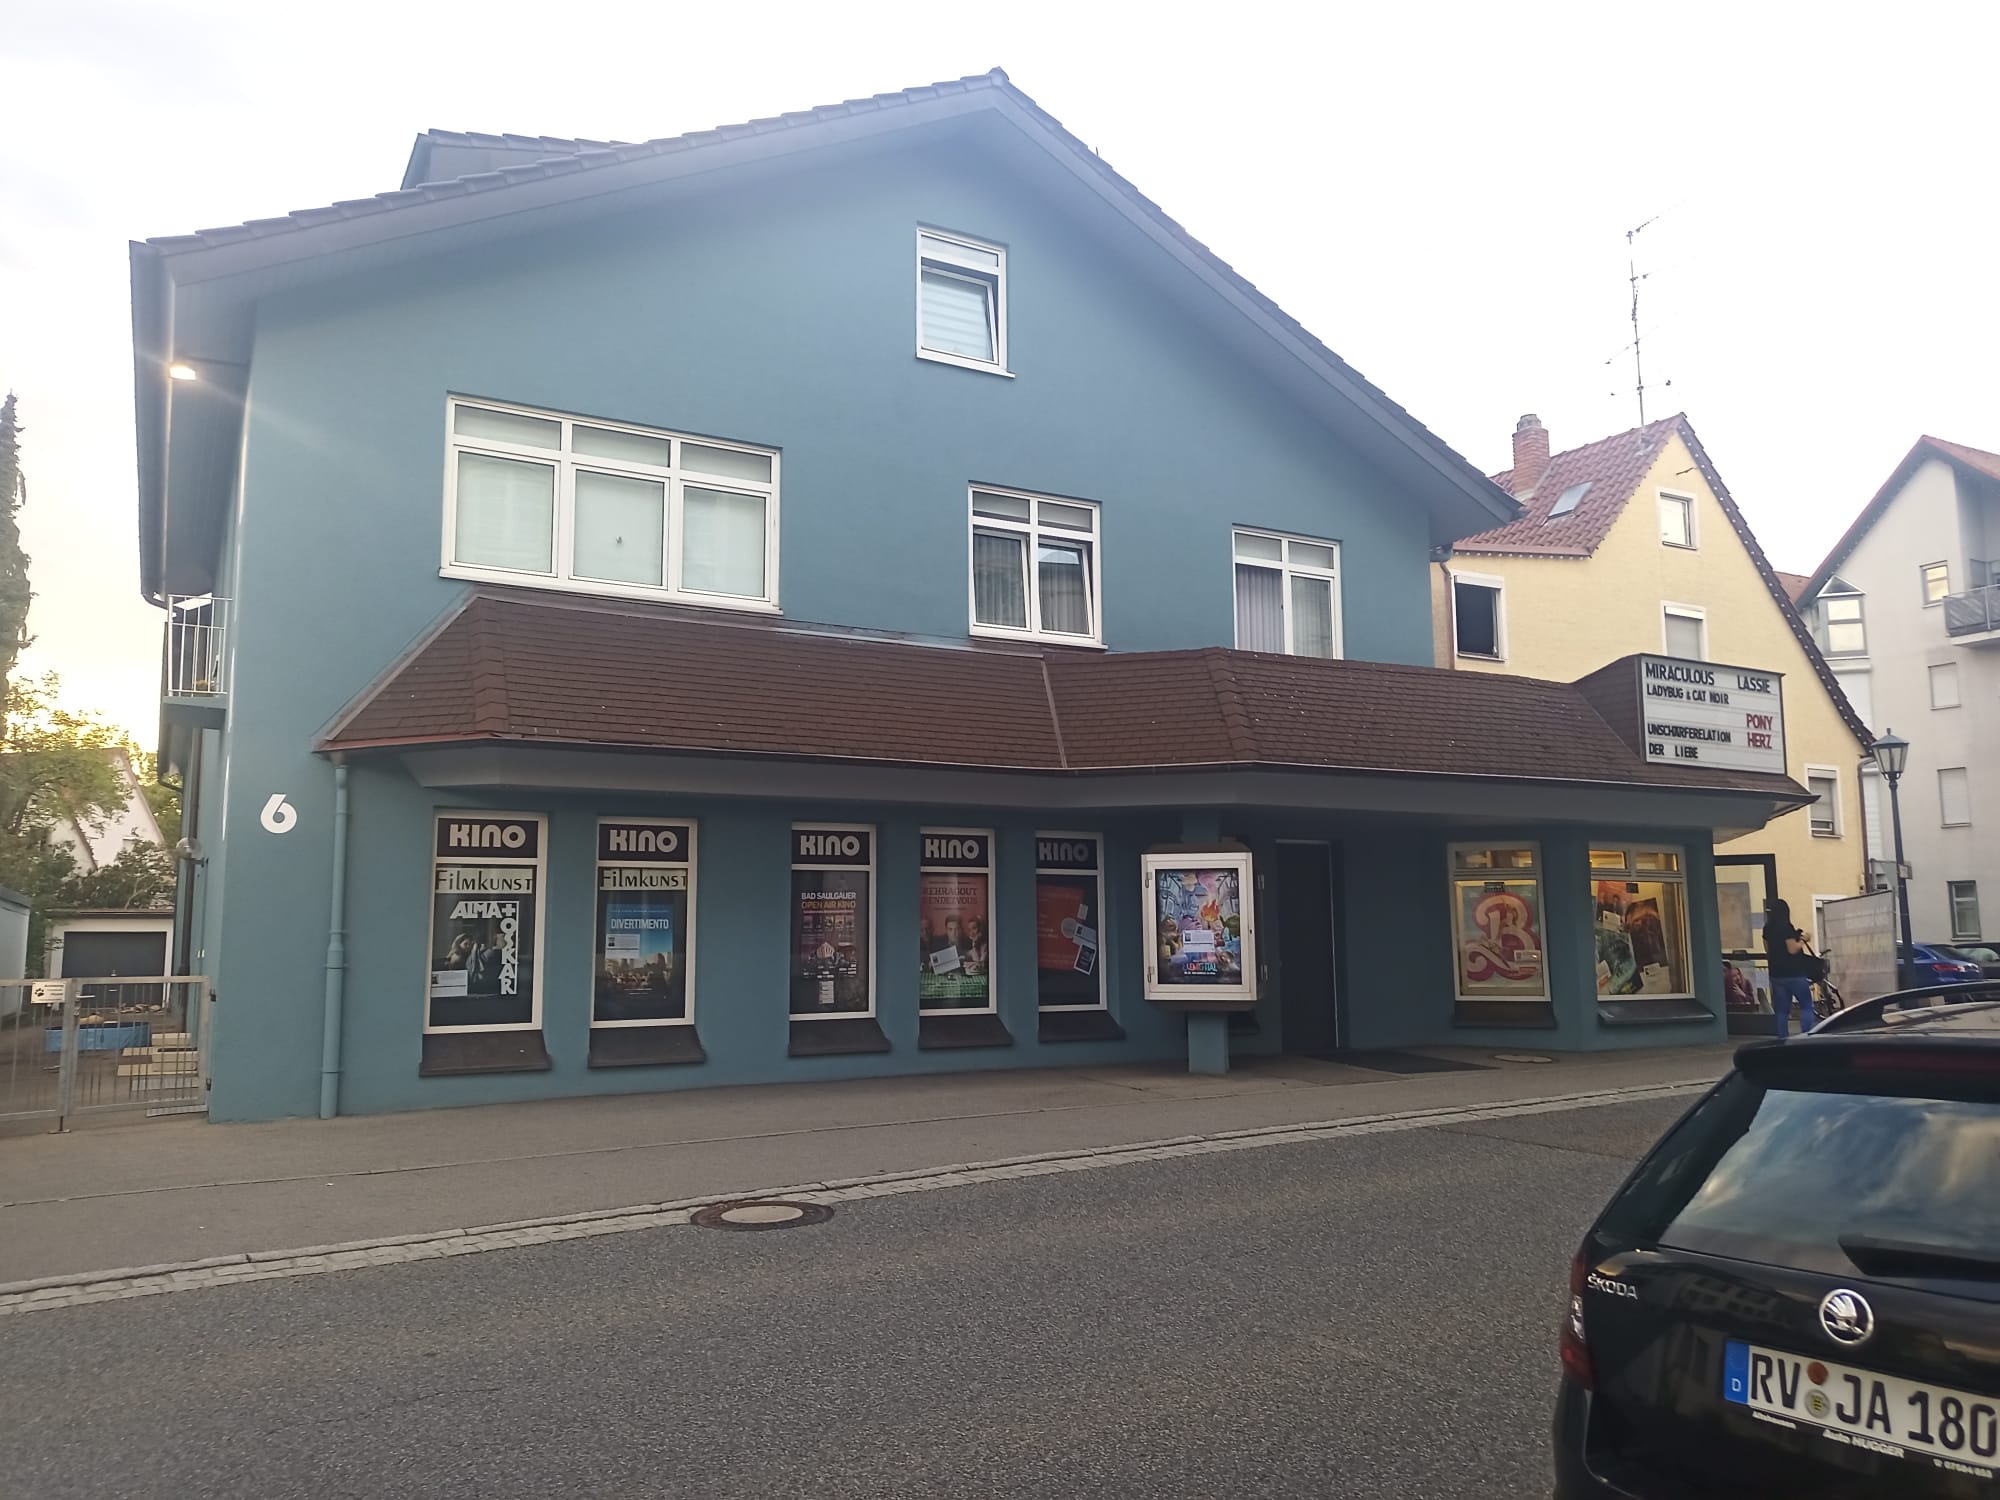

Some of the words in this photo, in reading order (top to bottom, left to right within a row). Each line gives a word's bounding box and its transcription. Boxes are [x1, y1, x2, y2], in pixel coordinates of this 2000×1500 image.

[1645, 662, 1714, 686] MIRACULOUS
[1737, 675, 1771, 694] LASSIE
[1646, 684, 1683, 699] LADYBUG
[1692, 690, 1706, 702] CAT
[1709, 692, 1729, 705] NOIR
[1746, 713, 1773, 731] PONY
[1648, 743, 1665, 756] DER
[1674, 745, 1698, 759] LIEBE
[1747, 732, 1773, 749] HERZ
[260, 793, 298, 834] 6
[450, 824, 526, 848] KINO
[609, 829, 678, 853] KINO
[800, 835, 860, 856] KINO
[925, 838, 980, 860] KINO
[1038, 841, 1089, 862] KINO
[801, 892, 816, 900] BAD
[801, 901, 823, 909] OPEN
[824, 901, 837, 909] AIR
[838, 901, 857, 909] KINO
[450, 901, 504, 919] ALMA
[610, 918, 669, 931] DIVERTIMENTO
[499, 917, 518, 995] OSKAR
[1588, 1272, 1638, 1301] ŠKODA
[1731, 1377, 1741, 1393] D
[1751, 1352, 1800, 1410] RV
[1836, 1373, 1892, 1435] JA
[1908, 1390, 1998, 1458] 180
